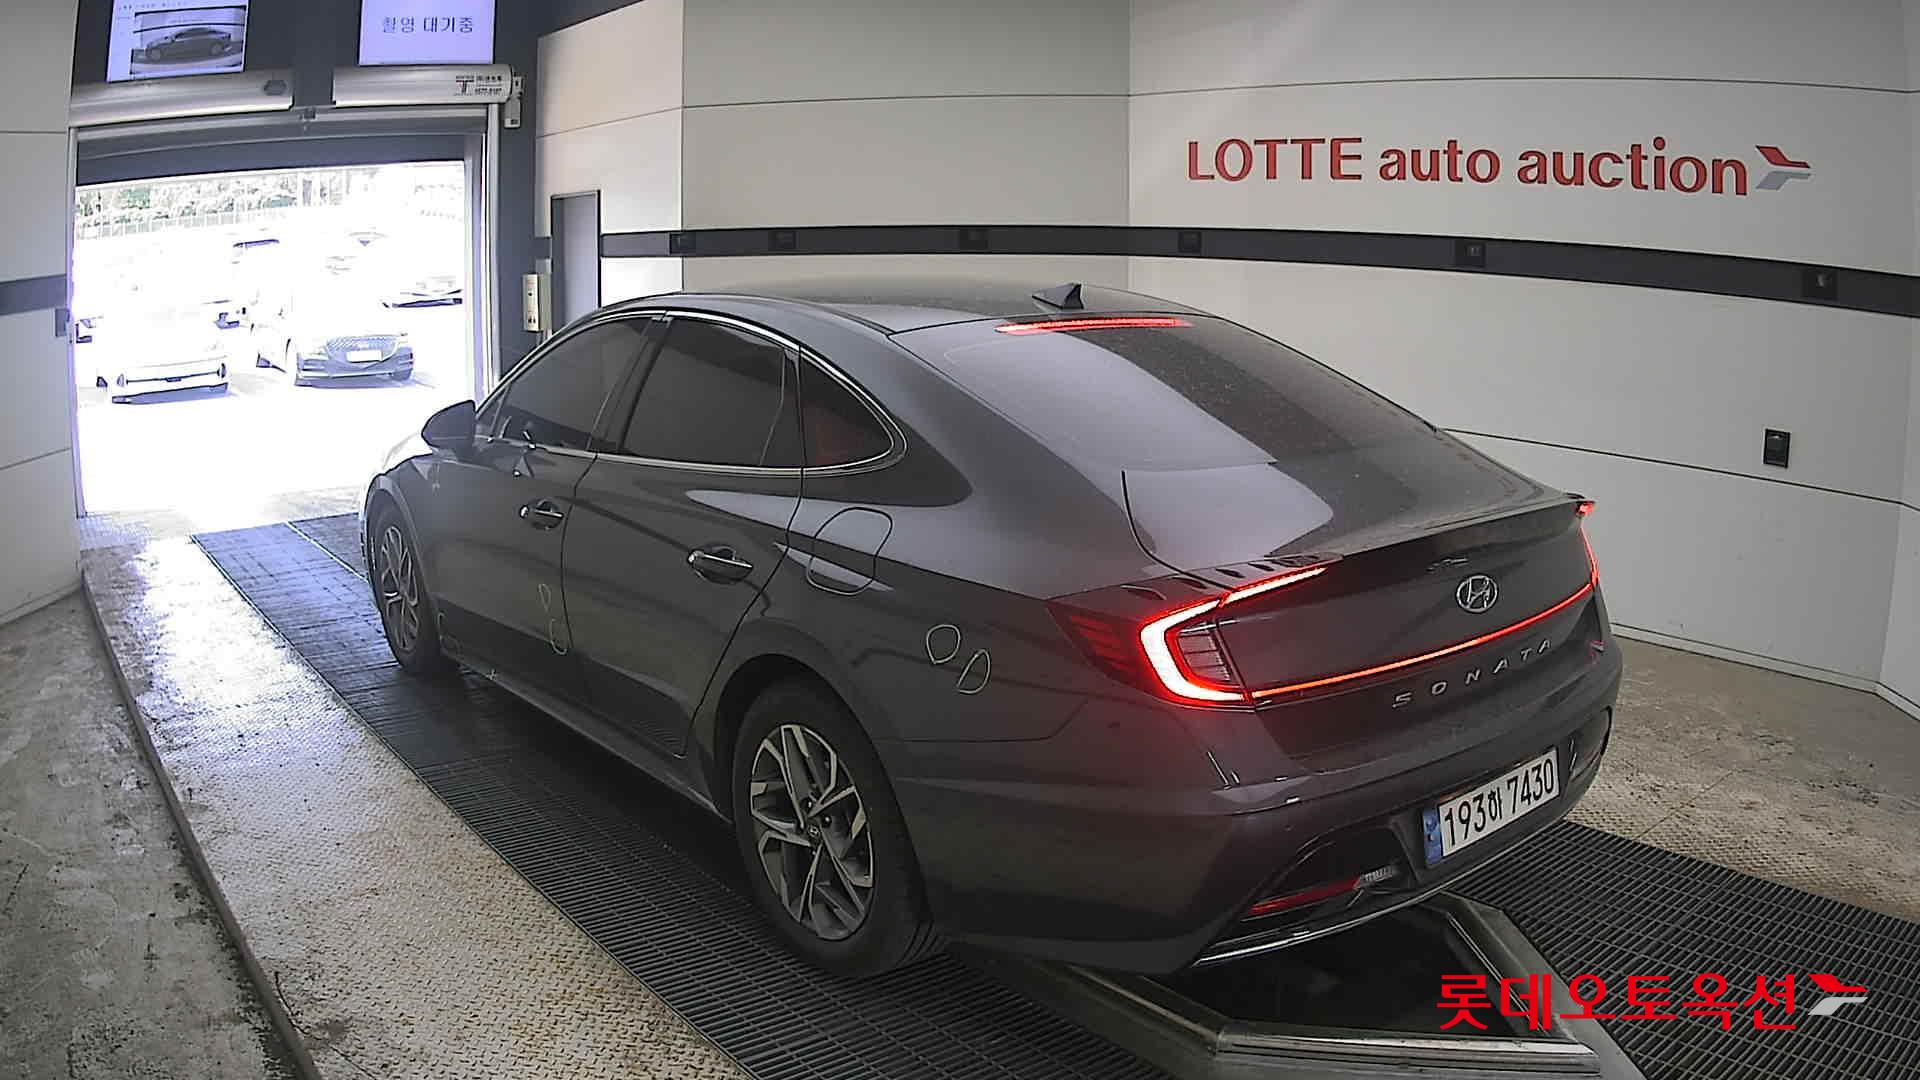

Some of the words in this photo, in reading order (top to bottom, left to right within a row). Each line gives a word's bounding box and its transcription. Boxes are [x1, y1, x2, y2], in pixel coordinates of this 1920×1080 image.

[423, 16, 473, 33] 대기중
[1187, 137, 1363, 182] LOTTE
[1379, 139, 1501, 184] auto
[1517, 136, 1748, 196] auction
[1392, 640, 1551, 709] SONATA
[1444, 788, 1503, 846] 193하
[1507, 759, 1554, 814] 7430
